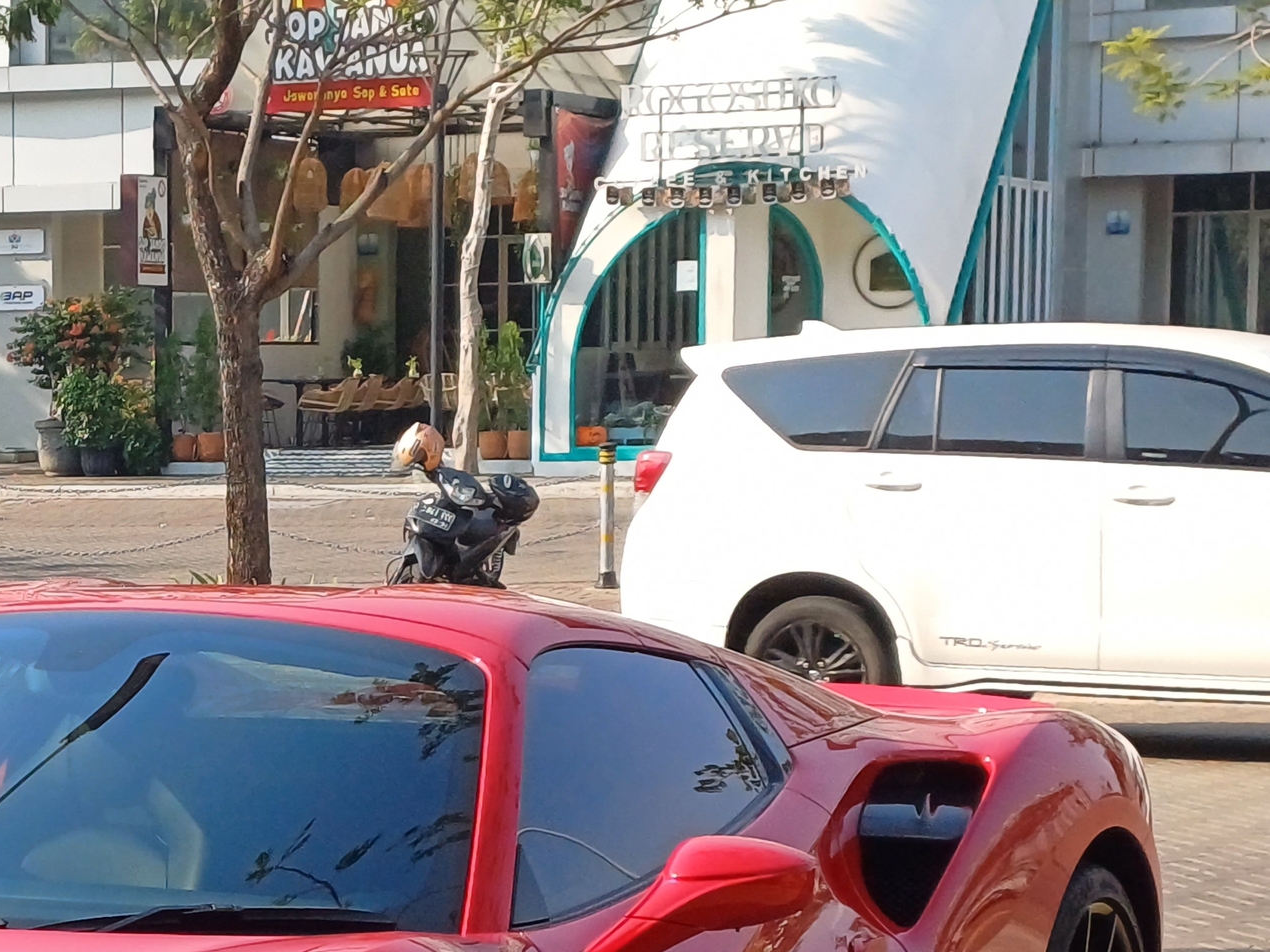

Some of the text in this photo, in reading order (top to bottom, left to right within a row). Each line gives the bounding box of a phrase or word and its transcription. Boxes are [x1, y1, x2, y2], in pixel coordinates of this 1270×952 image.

[268, 9, 327, 42] OP
[283, 89, 347, 103] Jawarnya
[379, 85, 387, 98] &
[715, 171, 728, 184] &
[747, 164, 866, 183] KITCHEN
[939, 636, 987, 648] TRD
